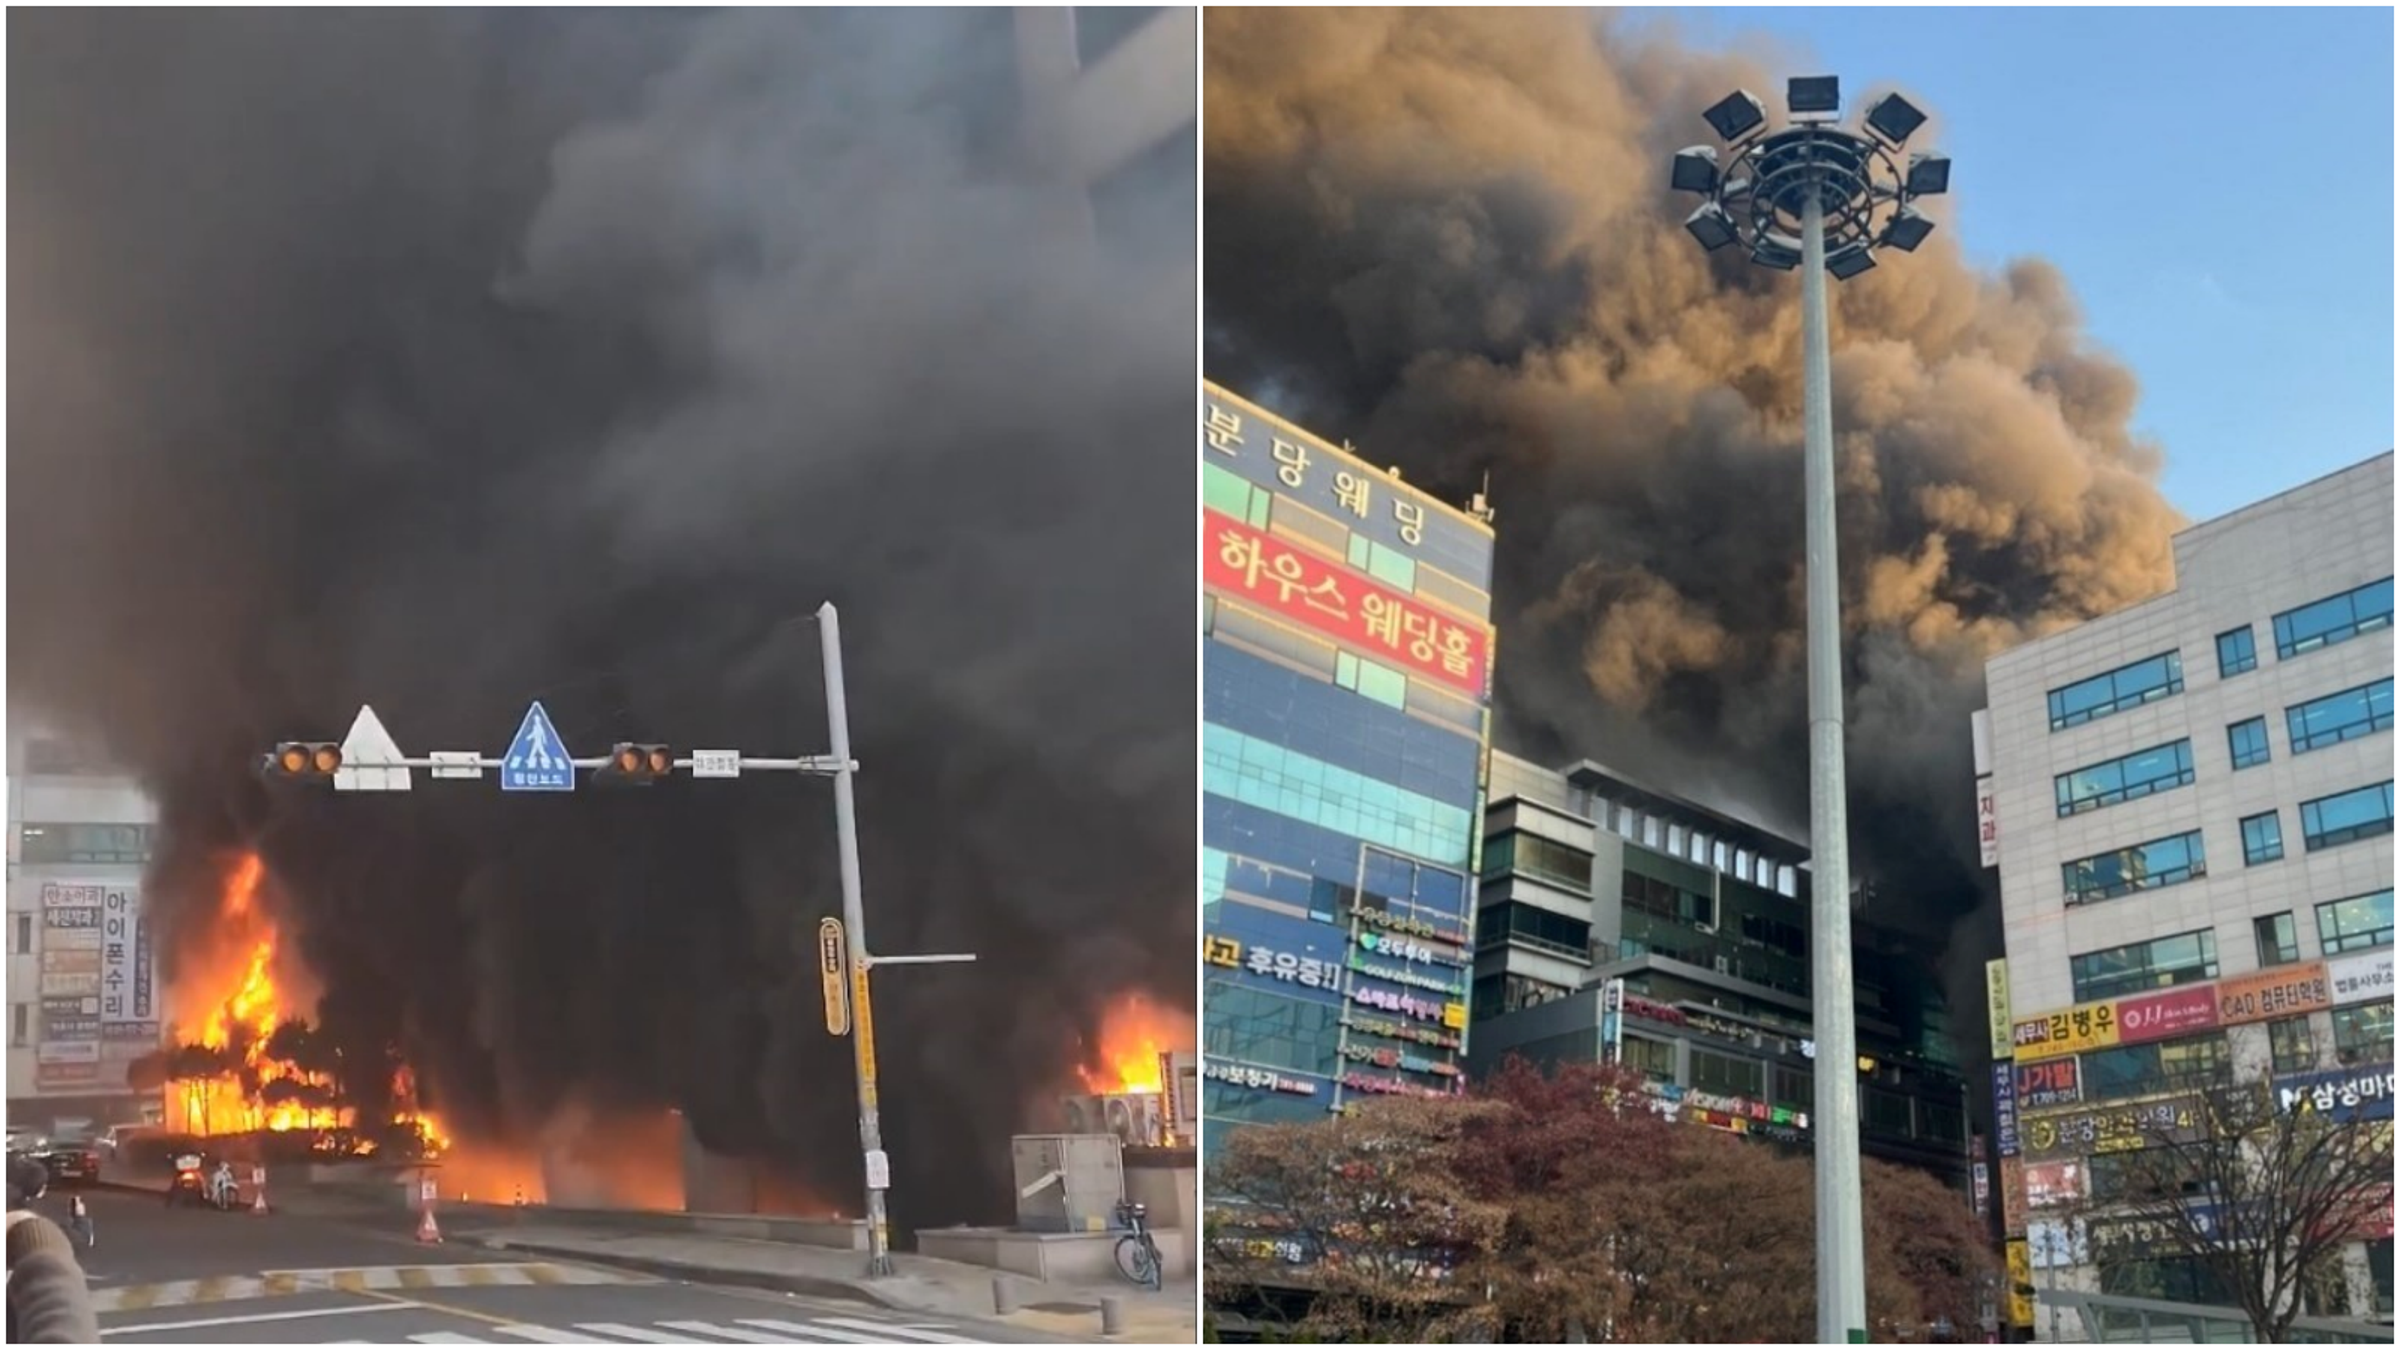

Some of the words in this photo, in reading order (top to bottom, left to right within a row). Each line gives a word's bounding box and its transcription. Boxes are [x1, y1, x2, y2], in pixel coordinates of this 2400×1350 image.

[1219, 530, 1349, 622] 하우스
[1360, 592, 1474, 678] 웨딩홀
[105, 892, 126, 1018] 아이폰수리
[1246, 945, 1322, 988] 후유증
[1376, 937, 1432, 965] 모두투어
[2015, 1018, 2048, 1044] 세무사
[2051, 1005, 2115, 1041] 김병우
[2221, 992, 2255, 1018] CAD
